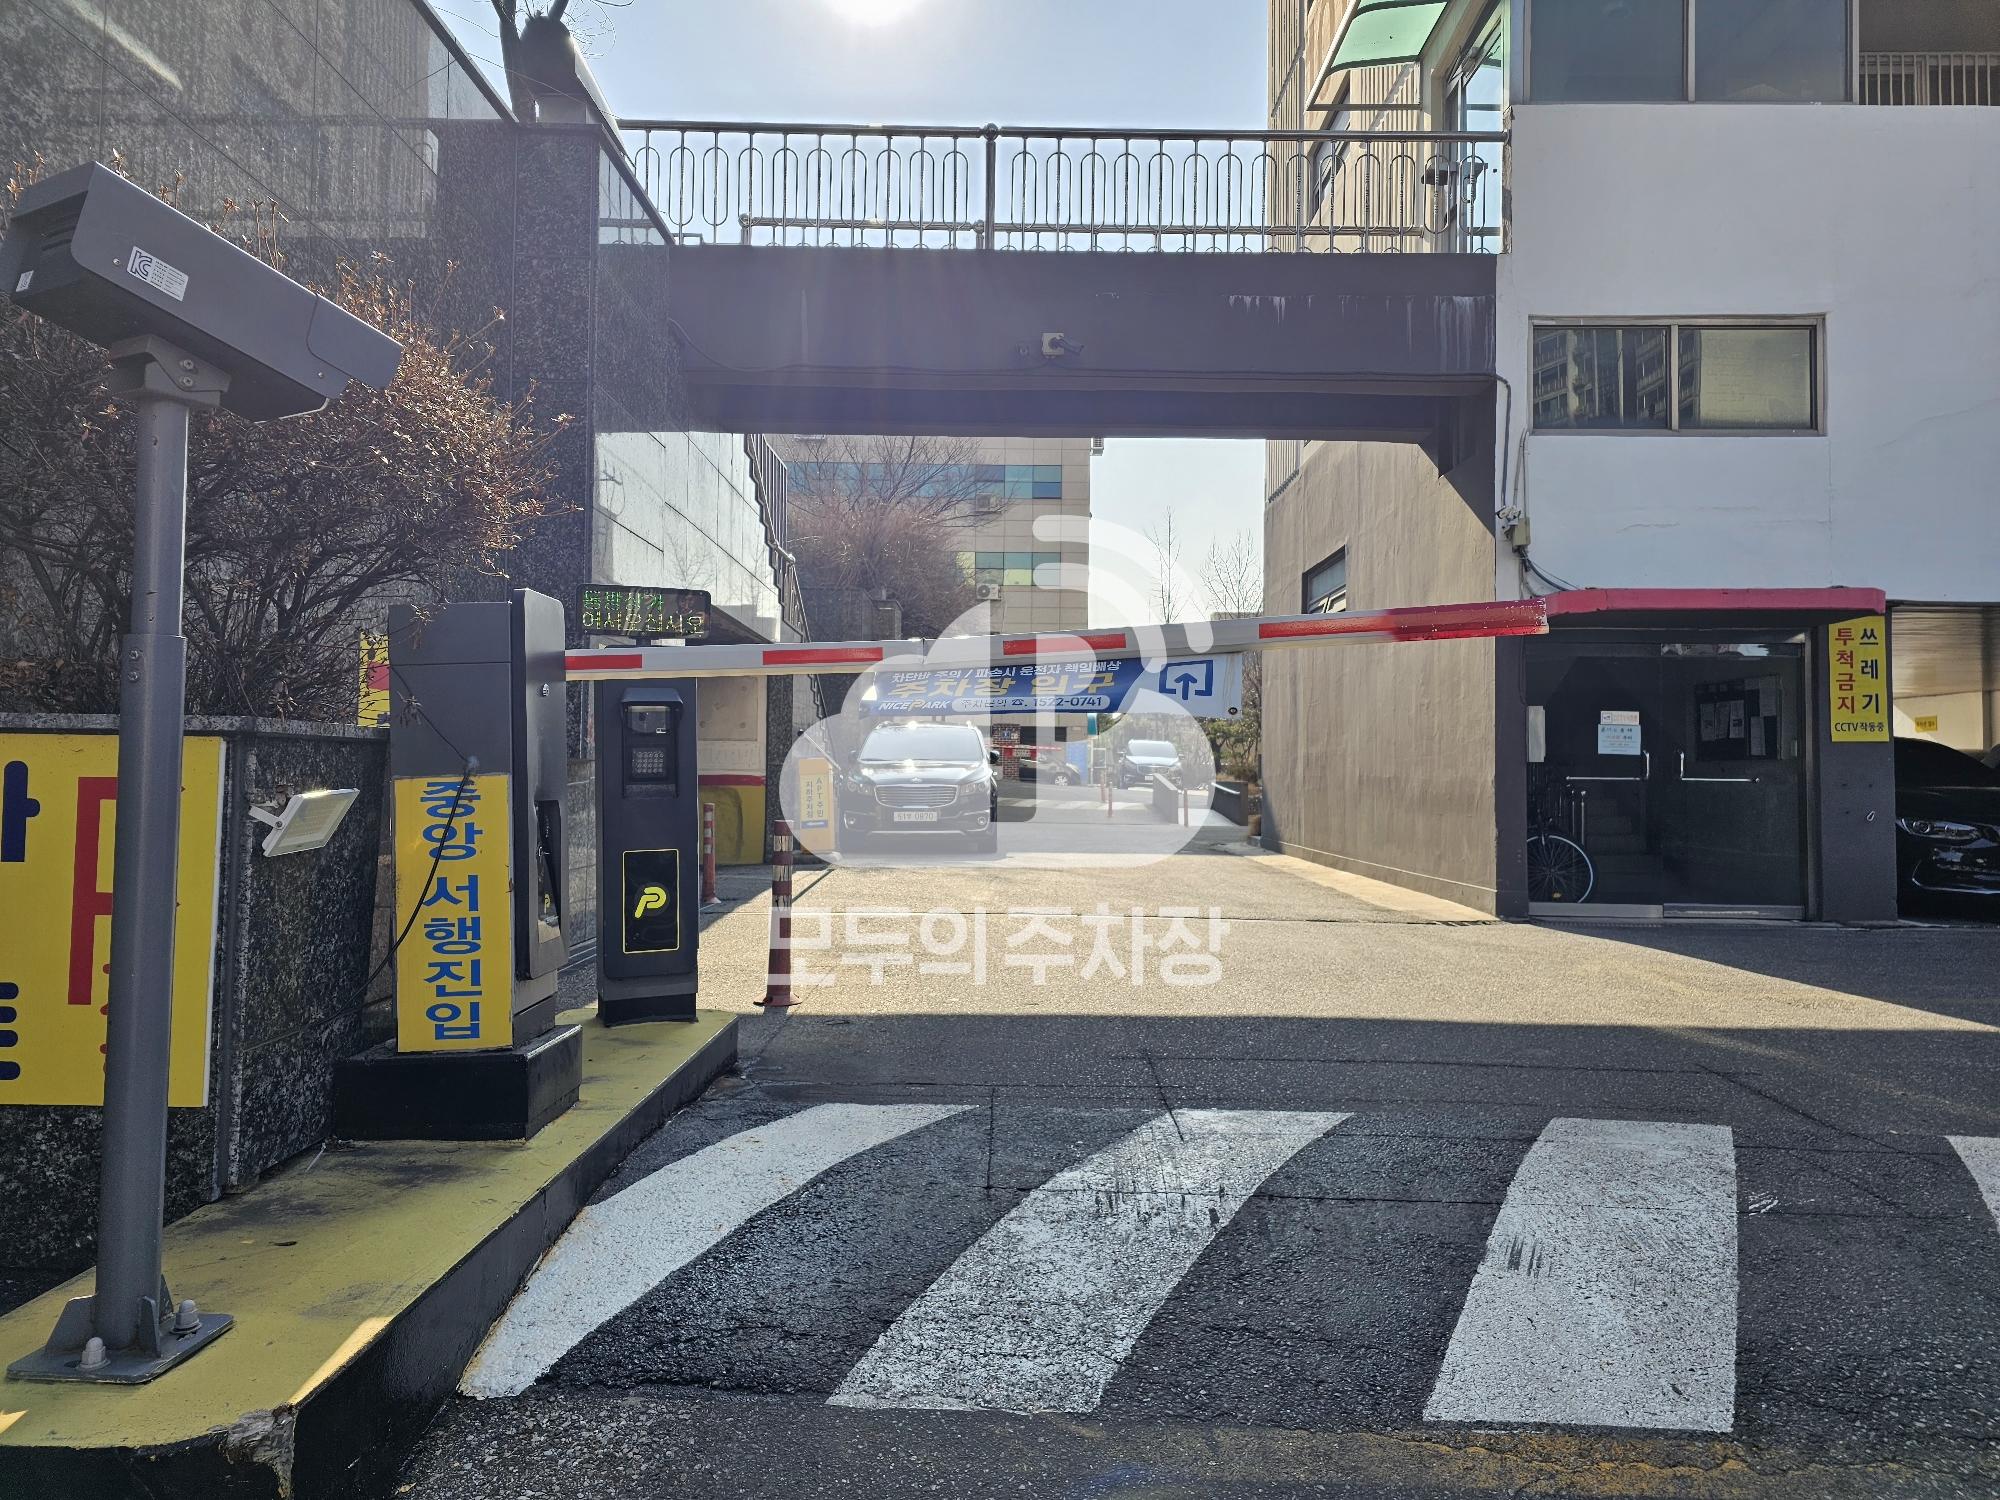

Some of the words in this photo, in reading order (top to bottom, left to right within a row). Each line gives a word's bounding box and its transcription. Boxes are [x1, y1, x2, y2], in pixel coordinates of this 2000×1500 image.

[888, 677, 1016, 698] 주차장
[1031, 672, 1115, 696] 입구
[934, 670, 962, 679] 주의
[975, 666, 1016, 679] 파손시
[1019, 663, 1061, 676] 운전자
[1064, 660, 1122, 673] 책임배상
[1034, 696, 1102, 707] 1522-0741
[1834, 628, 1855, 714] 투척금지
[1859, 628, 1879, 714] 쓰레기
[420, 781, 484, 861] 중앙
[422, 874, 483, 1041] 서행진입
